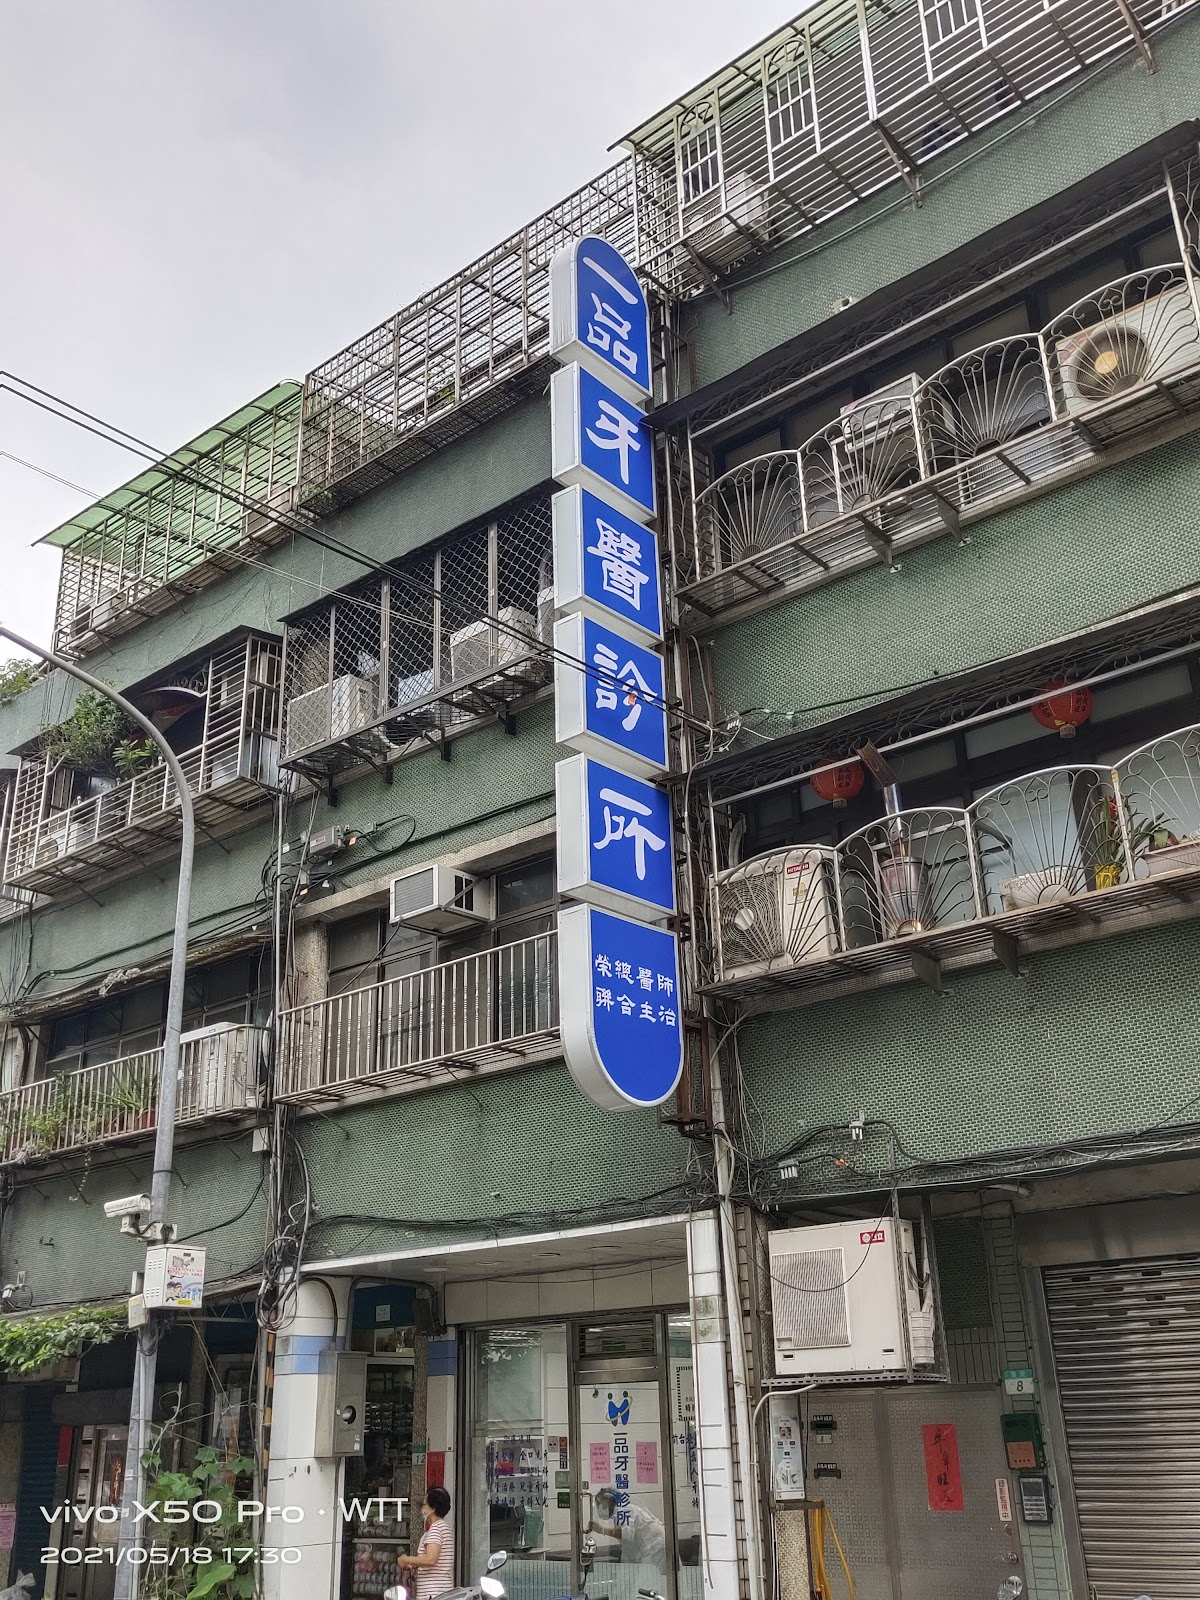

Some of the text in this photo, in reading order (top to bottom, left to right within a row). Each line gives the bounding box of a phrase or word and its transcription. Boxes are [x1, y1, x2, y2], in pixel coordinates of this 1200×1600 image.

[583, 256, 667, 881] 一品牙醫診所
[788, 862, 809, 874] HITAHI
[595, 953, 674, 998] 榮總醫師
[595, 986, 677, 1027] 聯合主治
[1016, 1380, 1024, 1392] 8
[613, 1432, 631, 1526] 一品牙醫診所
